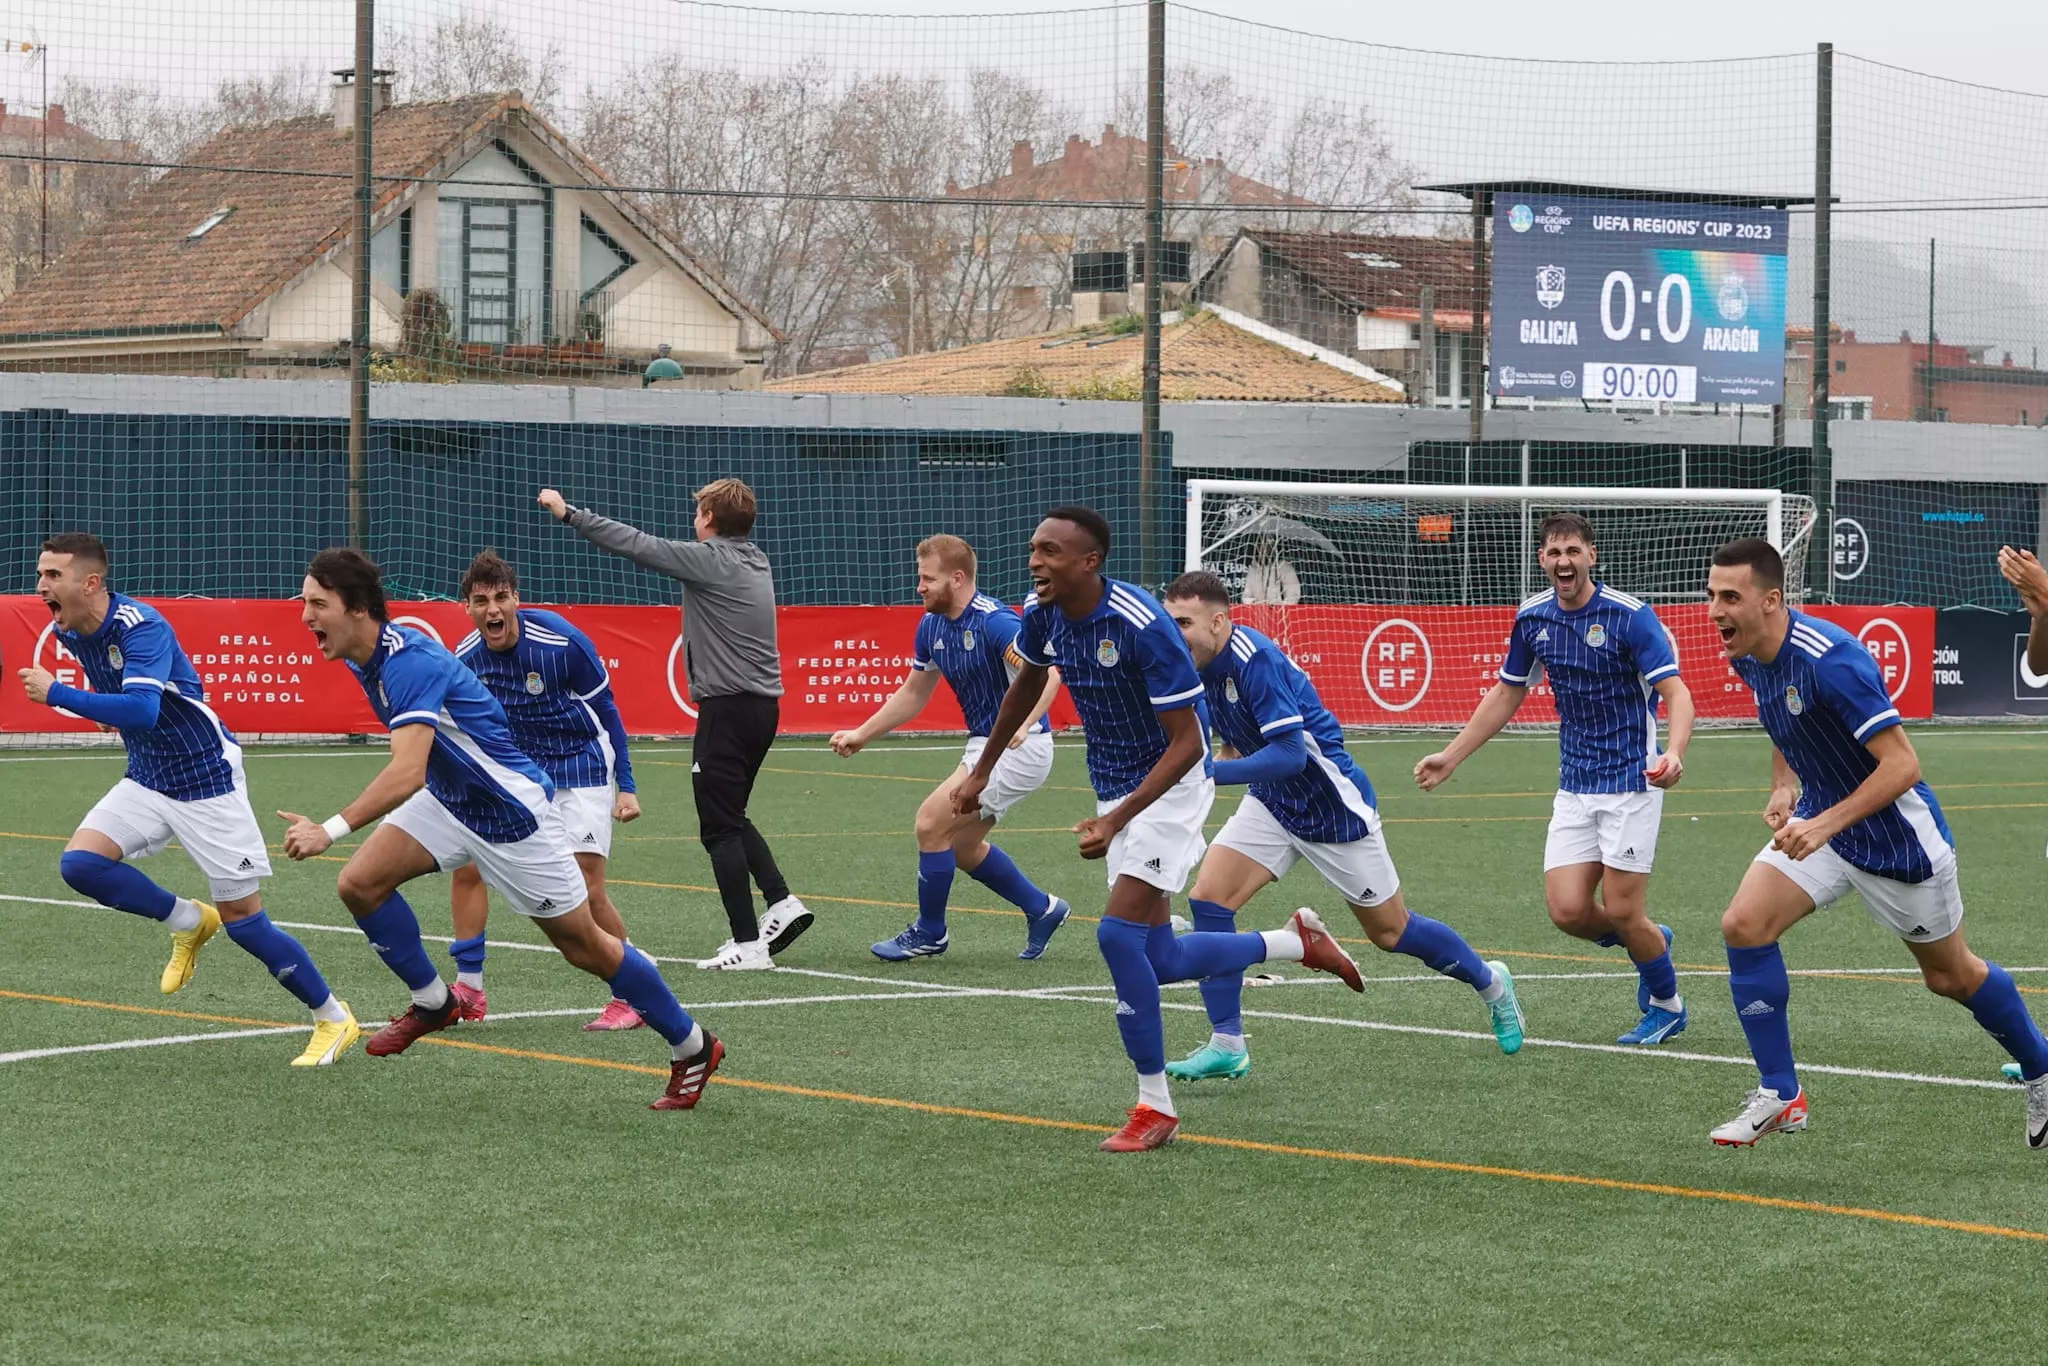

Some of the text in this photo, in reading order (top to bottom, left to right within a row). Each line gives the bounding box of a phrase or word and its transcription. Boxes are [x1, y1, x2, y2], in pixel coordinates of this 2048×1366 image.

[1593, 215, 1772, 240] UEFA REGIONS' CUP 2023
[1519, 319, 1578, 346] GALICIA
[1702, 327, 1760, 352] ARAGÓN
[1602, 366, 1679, 399] 90:00
[1834, 533, 1859, 547] RF
[1834, 551, 1859, 564] EF
[220, 635, 272, 646] REAL
[834, 640, 880, 650] REAL
[1378, 642, 1416, 662] RF
[1866, 640, 1898, 660] RF
[185, 652, 313, 665] EDERACIÓN
[798, 655, 915, 668] FEDERACIÓN
[197, 670, 300, 684] SPAÑOLA
[808, 674, 904, 685] ESPAÑOLA
[1378, 668, 1416, 688] EF
[1932, 670, 1964, 685] TBOL
[1724, 683, 1743, 692] DE
[223, 689, 305, 703] FÚTBOL
[805, 694, 828, 704] DE
